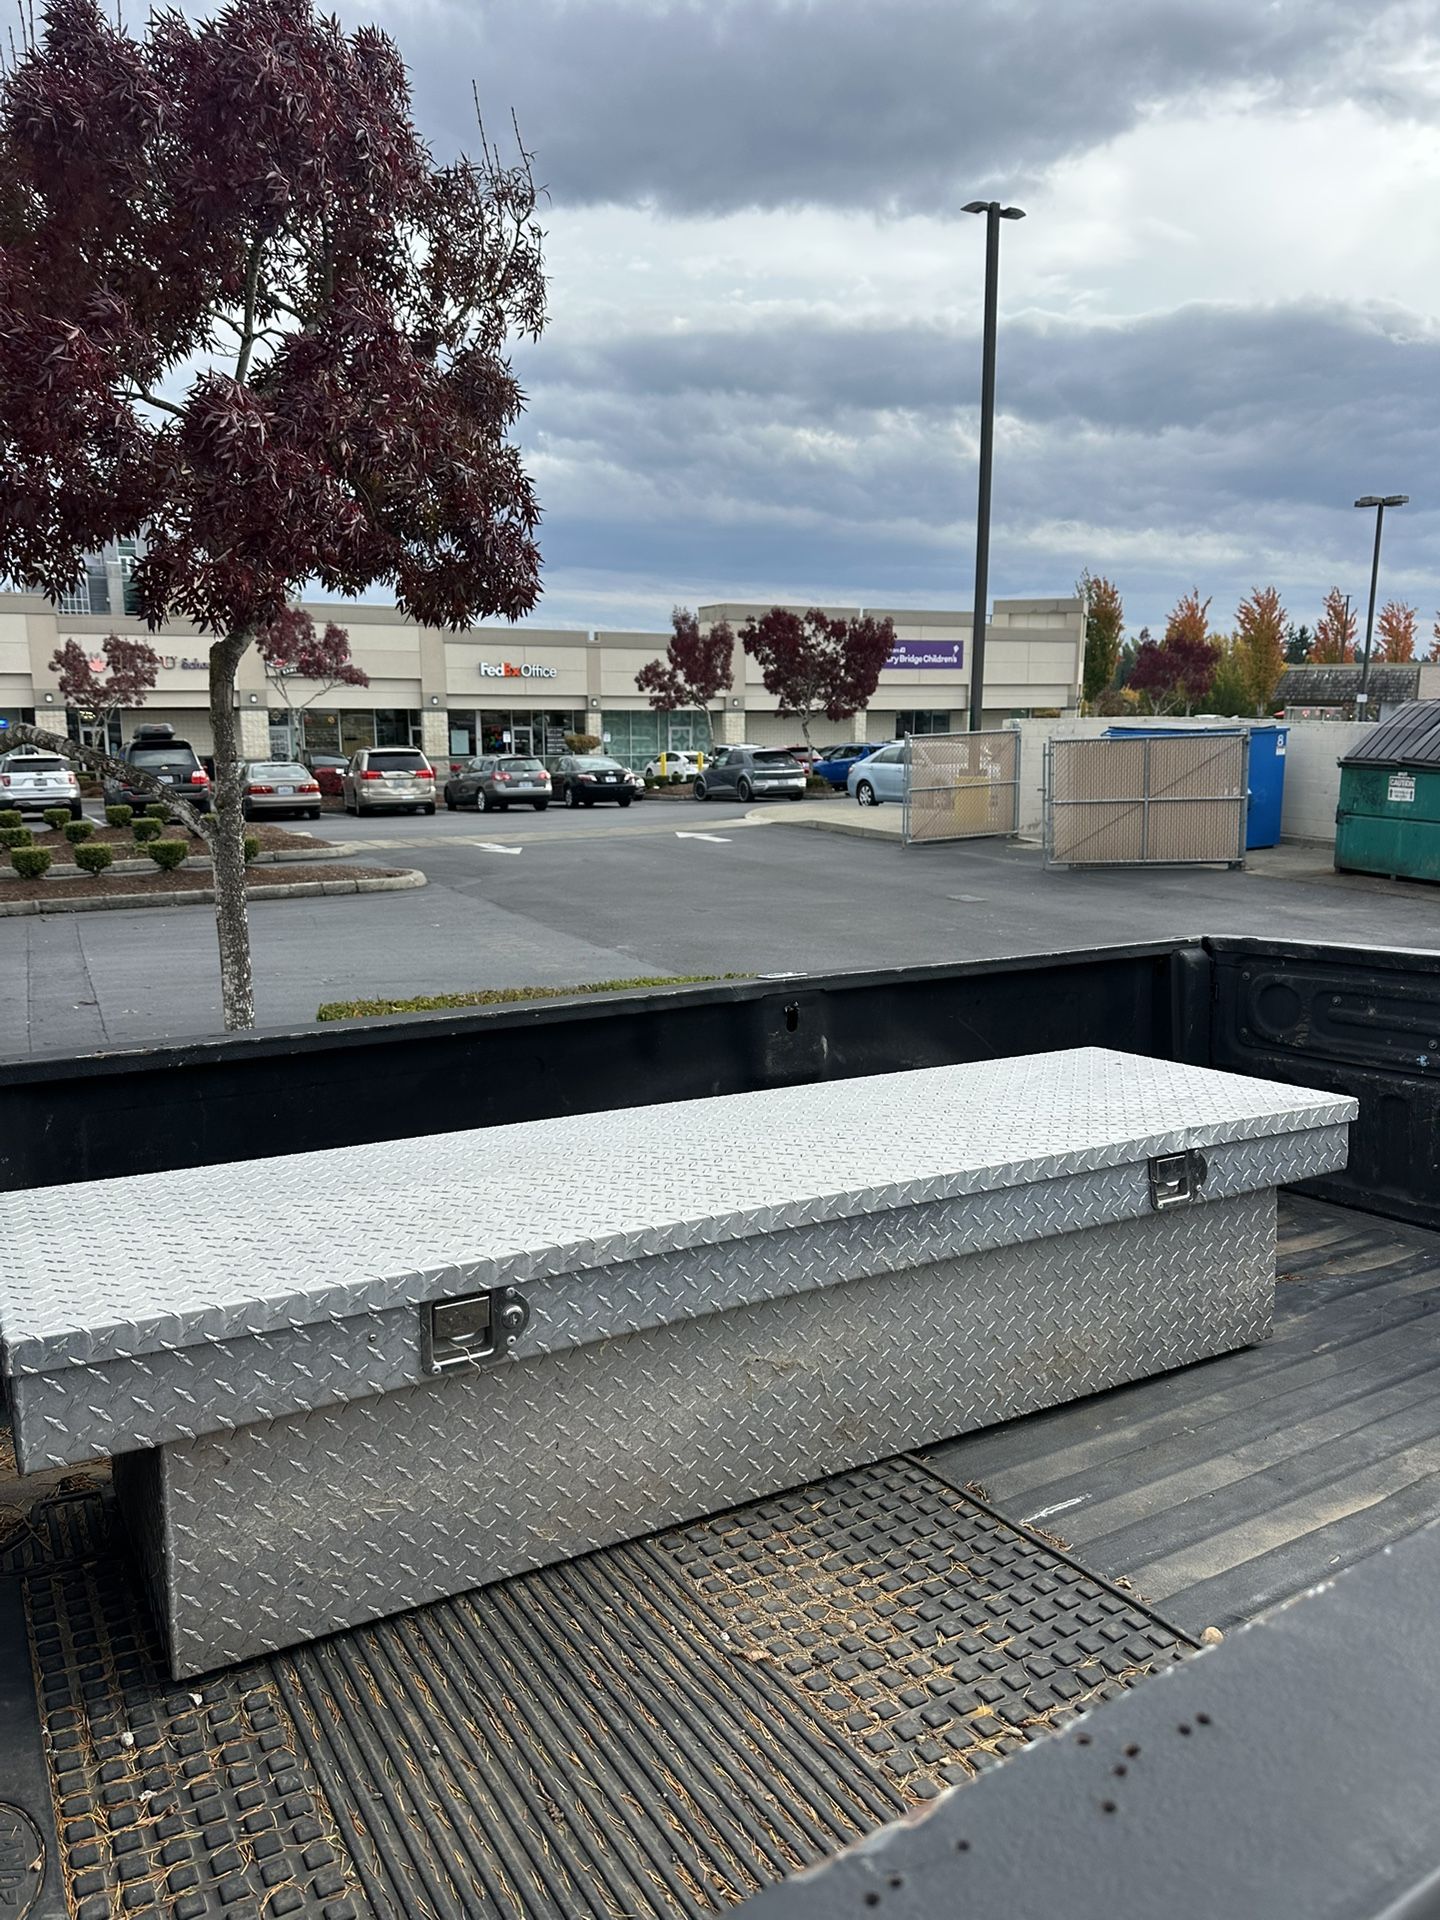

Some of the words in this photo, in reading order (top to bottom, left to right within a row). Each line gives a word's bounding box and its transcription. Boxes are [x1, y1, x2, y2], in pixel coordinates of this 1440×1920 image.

[899, 655, 922, 665] Bridge
[479, 662, 520, 677] FedEx
[521, 663, 557, 678] Office
[1277, 734, 1284, 746] 8
[1389, 778, 1415, 788] CAUTION
